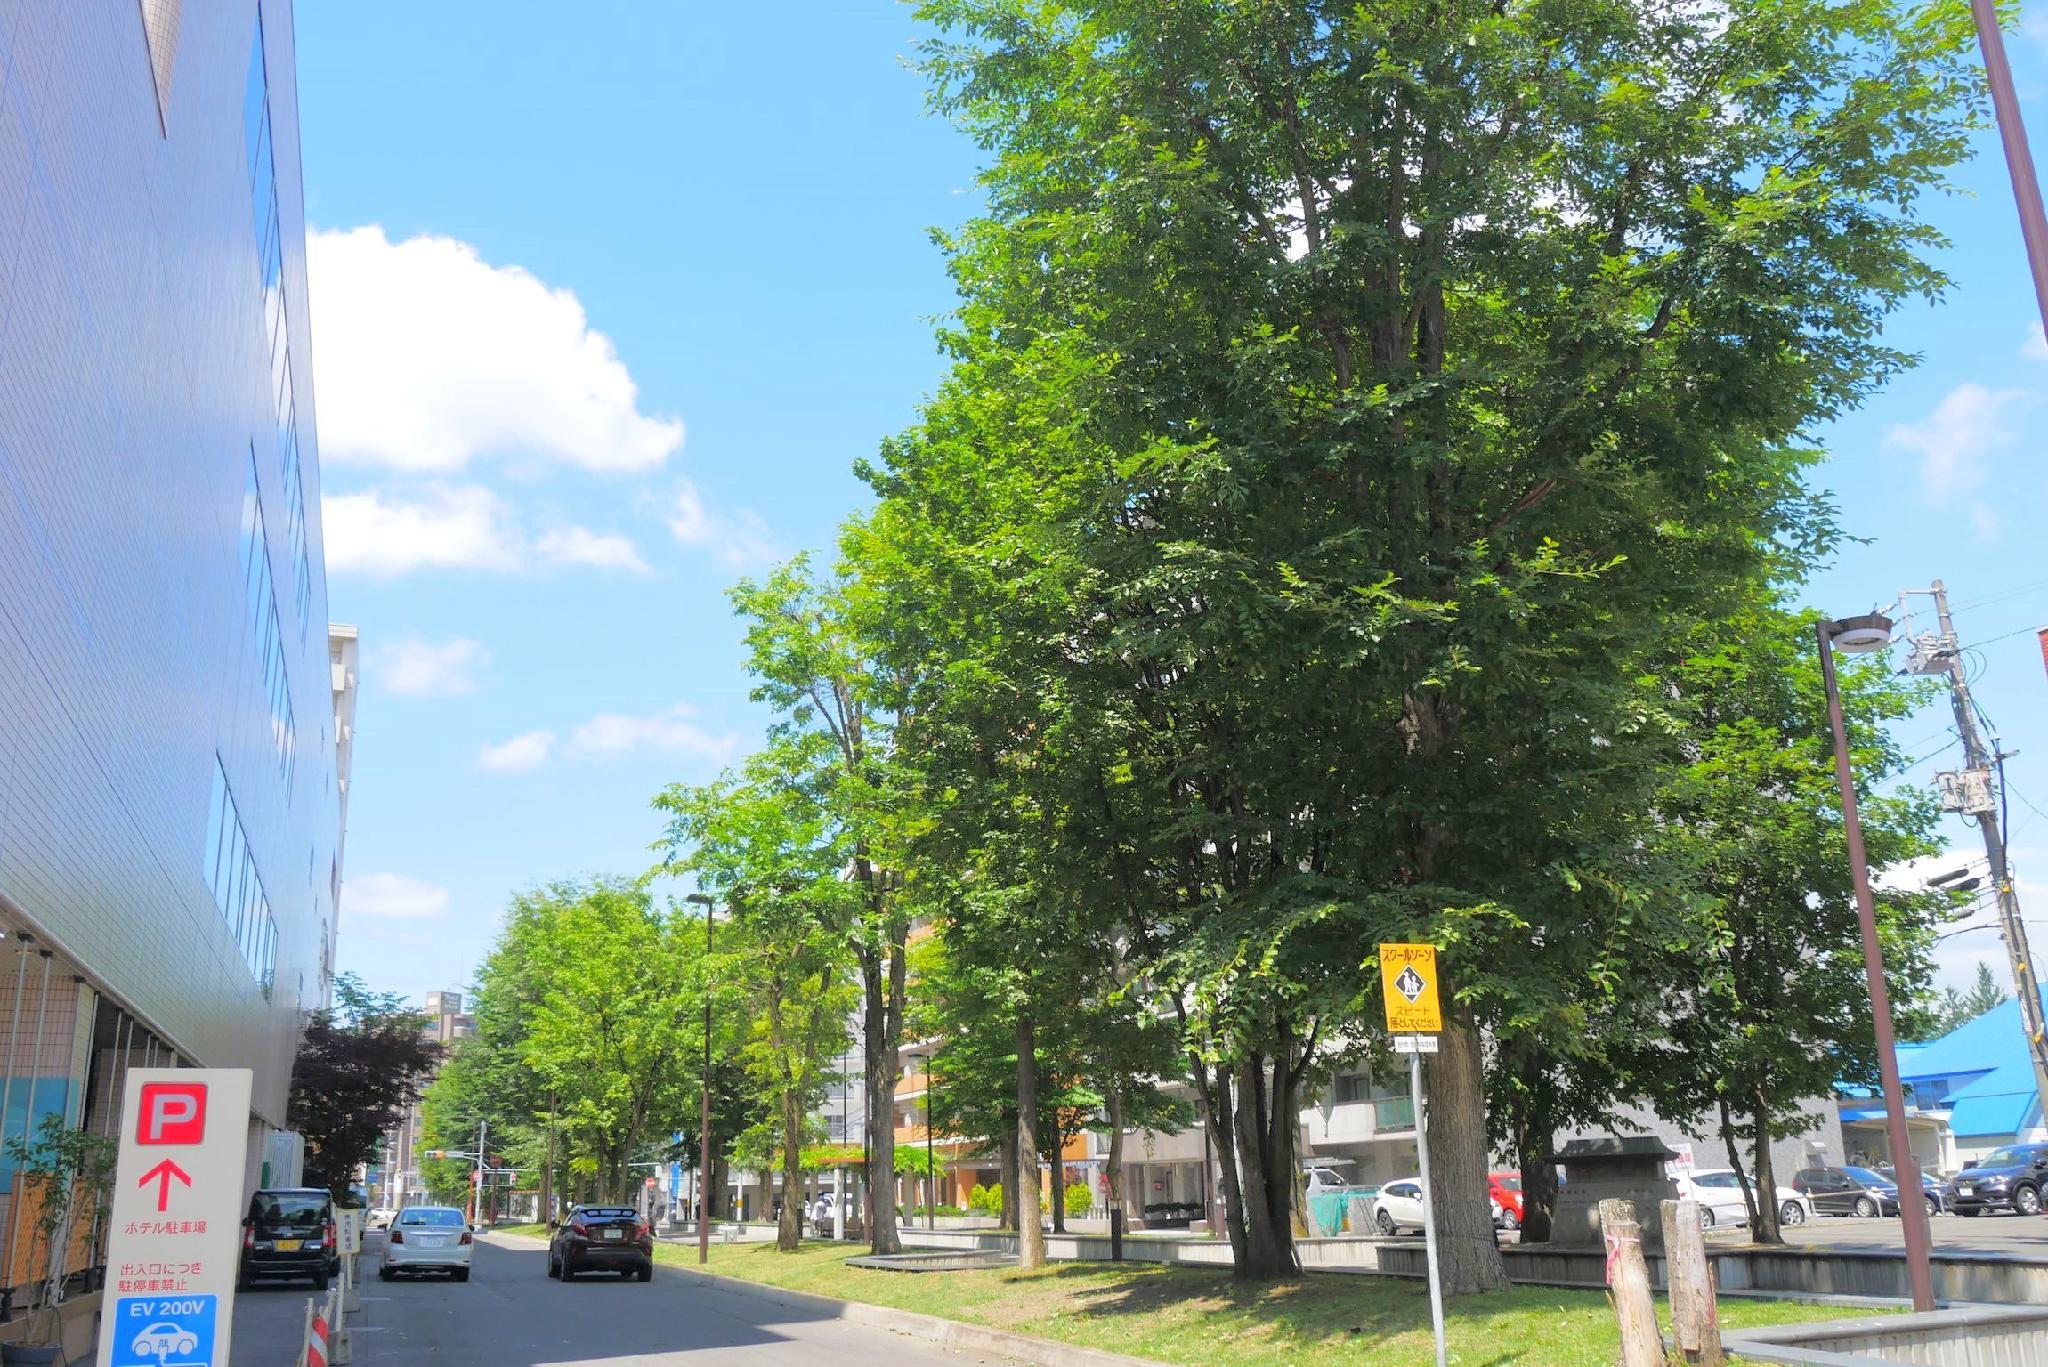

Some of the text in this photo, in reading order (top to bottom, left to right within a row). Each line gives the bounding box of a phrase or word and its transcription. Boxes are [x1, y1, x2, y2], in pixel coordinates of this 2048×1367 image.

[1382, 948, 1432, 962] スクールゾーン
[1390, 1017, 1438, 1029] 落としてください
[149, 1093, 198, 1140] P
[124, 1221, 207, 1235] ホテル駐車場
[118, 1279, 188, 1293] 駐停車禁止
[130, 1300, 205, 1317] EV 200V
